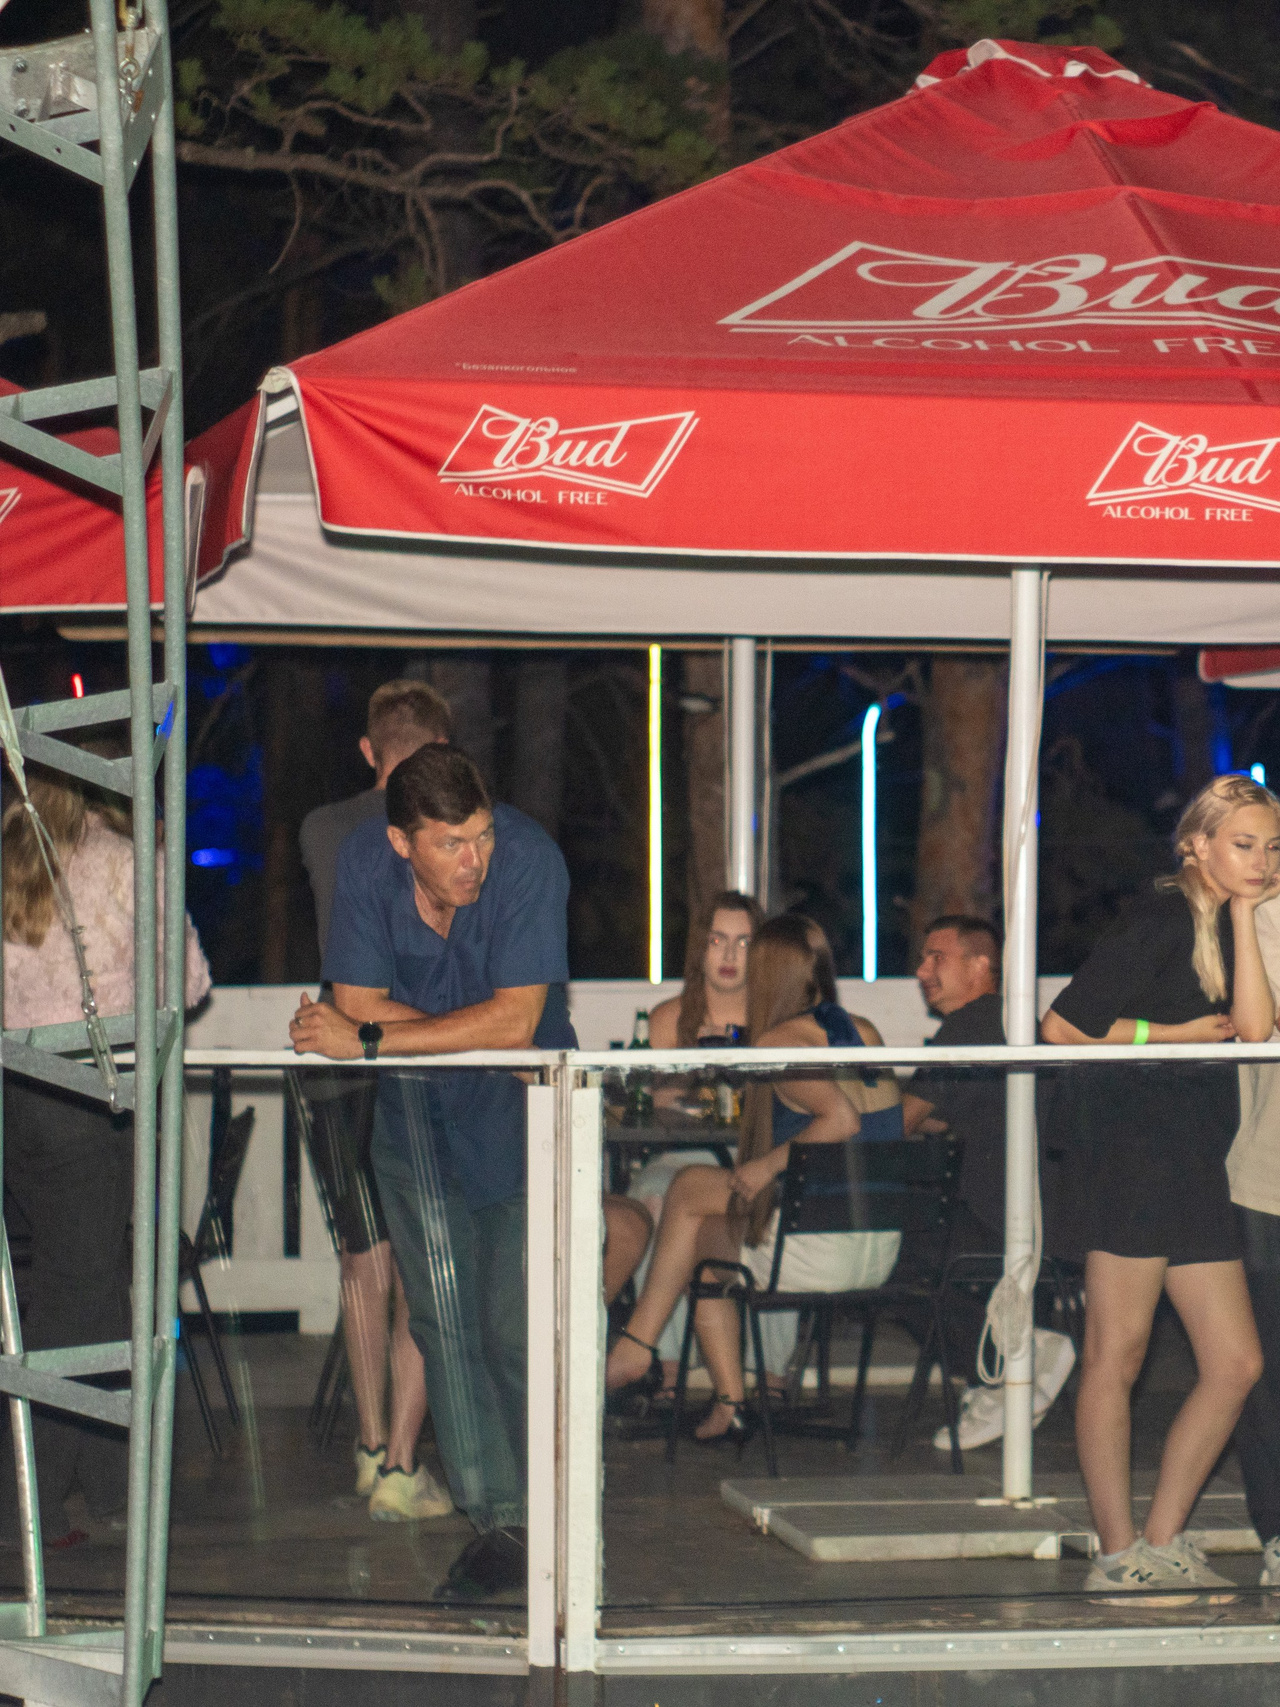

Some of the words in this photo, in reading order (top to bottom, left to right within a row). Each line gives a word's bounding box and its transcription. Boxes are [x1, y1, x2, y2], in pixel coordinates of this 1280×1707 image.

[787, 334, 1120, 353] ALCOHOL
[481, 416, 628, 469] Bud
[1132, 433, 1272, 487] Bud
[454, 483, 548, 504] ALCOHOL
[557, 490, 609, 506] FREE
[1102, 505, 1196, 521] ALCOHOL
[1204, 508, 1254, 522] FREE
